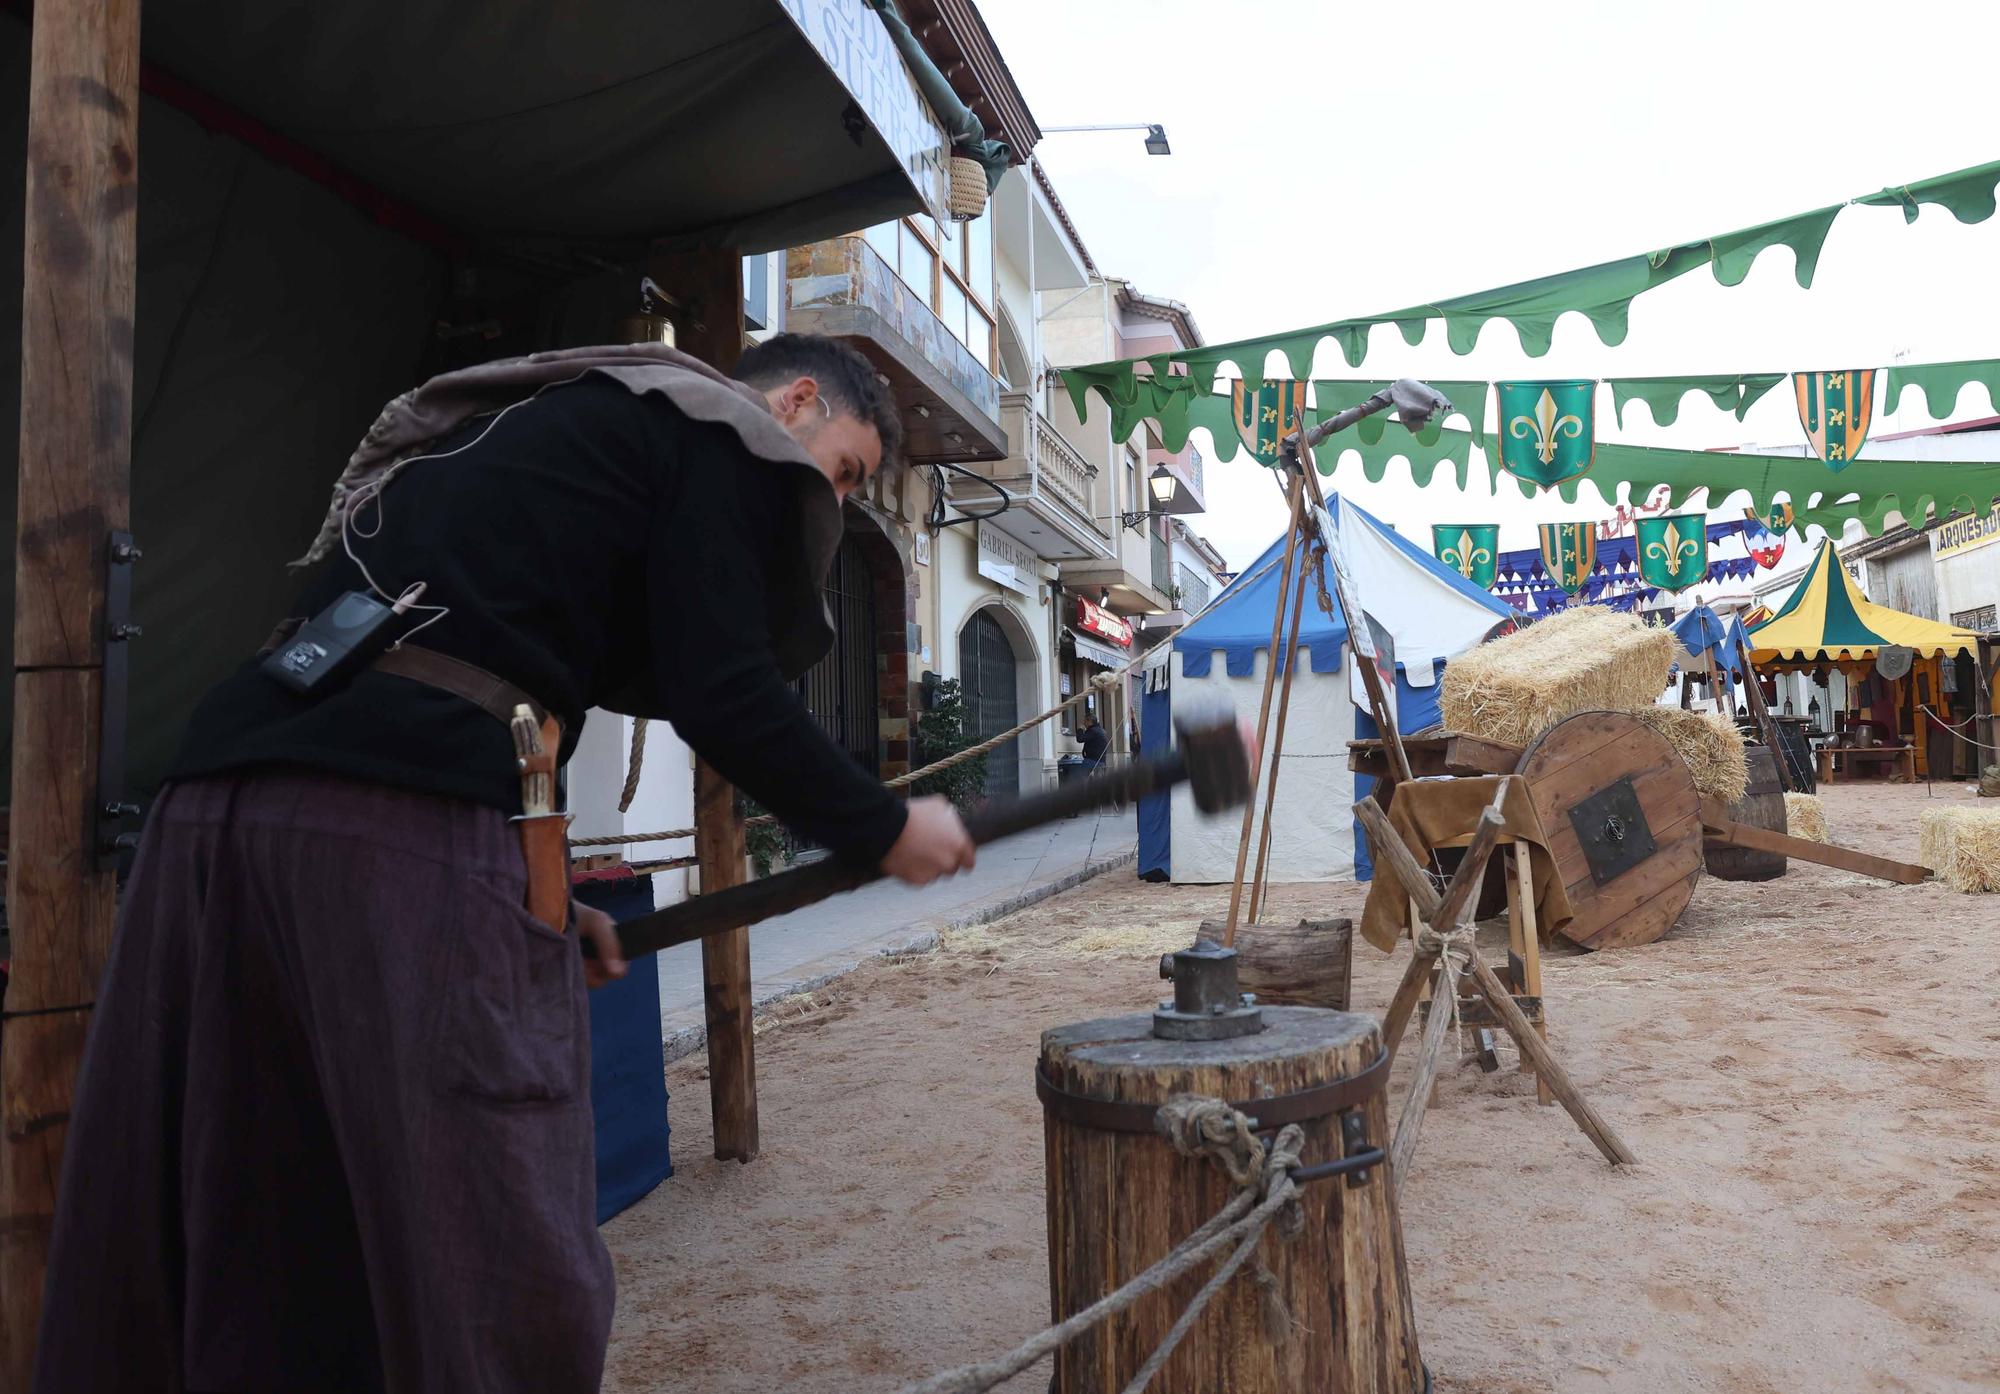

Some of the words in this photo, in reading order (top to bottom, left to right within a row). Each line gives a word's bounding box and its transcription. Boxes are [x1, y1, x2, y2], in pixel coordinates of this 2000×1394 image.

[823, 6, 934, 211] SUERTE
[980, 529, 1014, 565] GABRIEL
[1936, 507, 2000, 552] ARQUESAD
